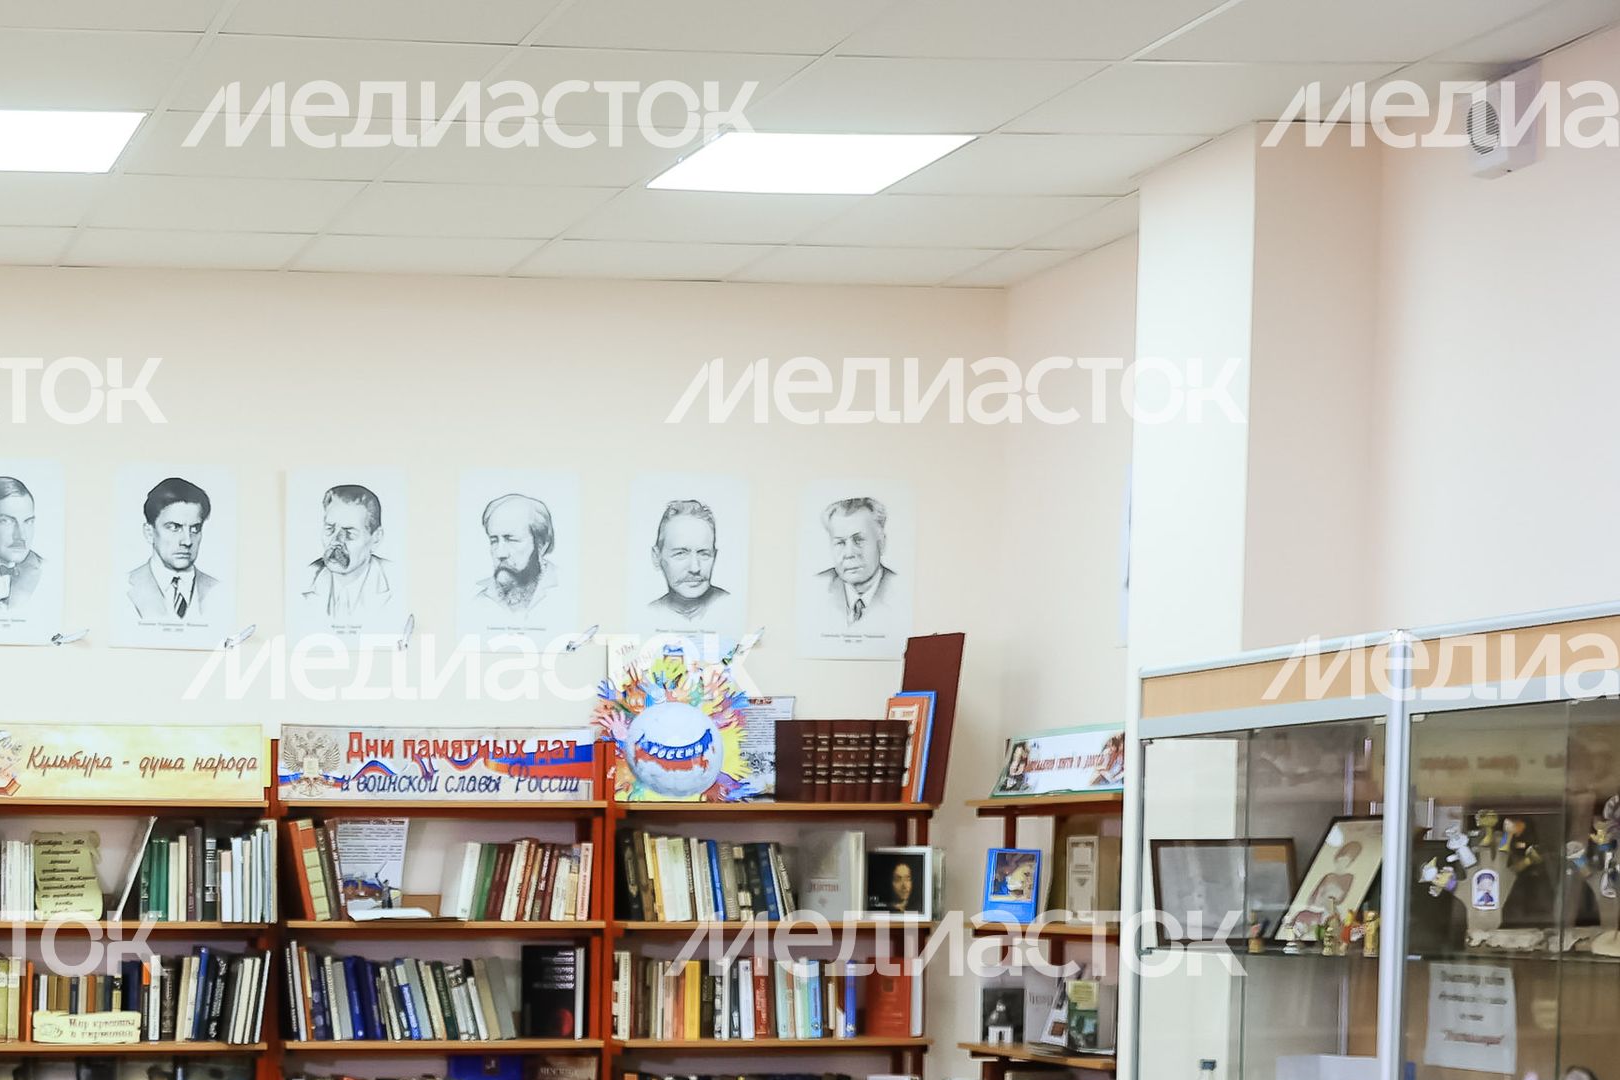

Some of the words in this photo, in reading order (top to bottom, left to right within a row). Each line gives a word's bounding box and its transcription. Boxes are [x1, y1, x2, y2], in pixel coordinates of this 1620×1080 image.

[26, 745, 113, 777] Культура
[139, 755, 186, 778] душа
[193, 753, 258, 779] народа
[346, 731, 394, 763] Дни
[403, 738, 526, 761] памятных
[535, 739, 577, 761] дат
[340, 776, 351, 792] и
[356, 769, 440, 793] воинской
[445, 774, 503, 793] славы
[508, 762, 580, 793] России
